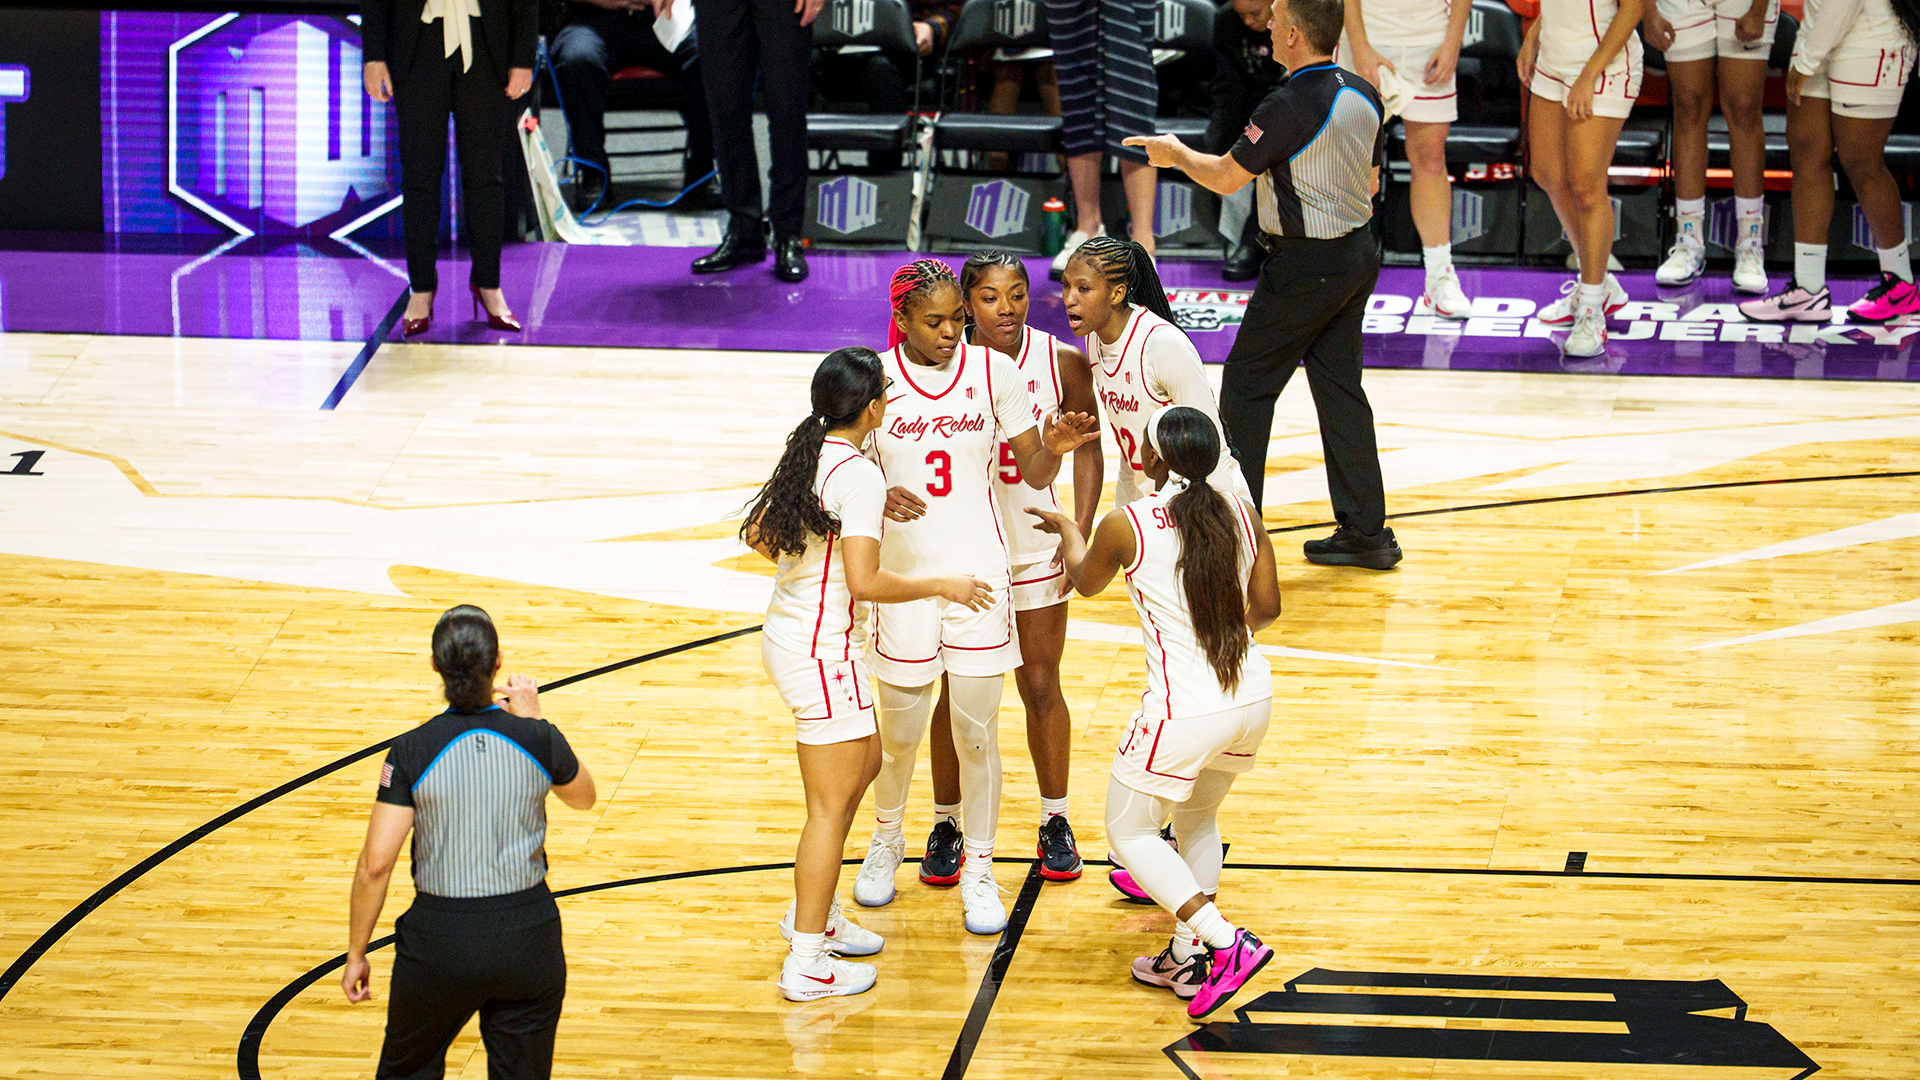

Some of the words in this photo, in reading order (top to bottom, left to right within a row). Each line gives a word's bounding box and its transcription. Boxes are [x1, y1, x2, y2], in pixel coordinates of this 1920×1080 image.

[1606, 320, 1920, 346] JERKY
[888, 415, 929, 442] Lady
[932, 413, 985, 439] Rebels
[925, 450, 952, 497] 3
